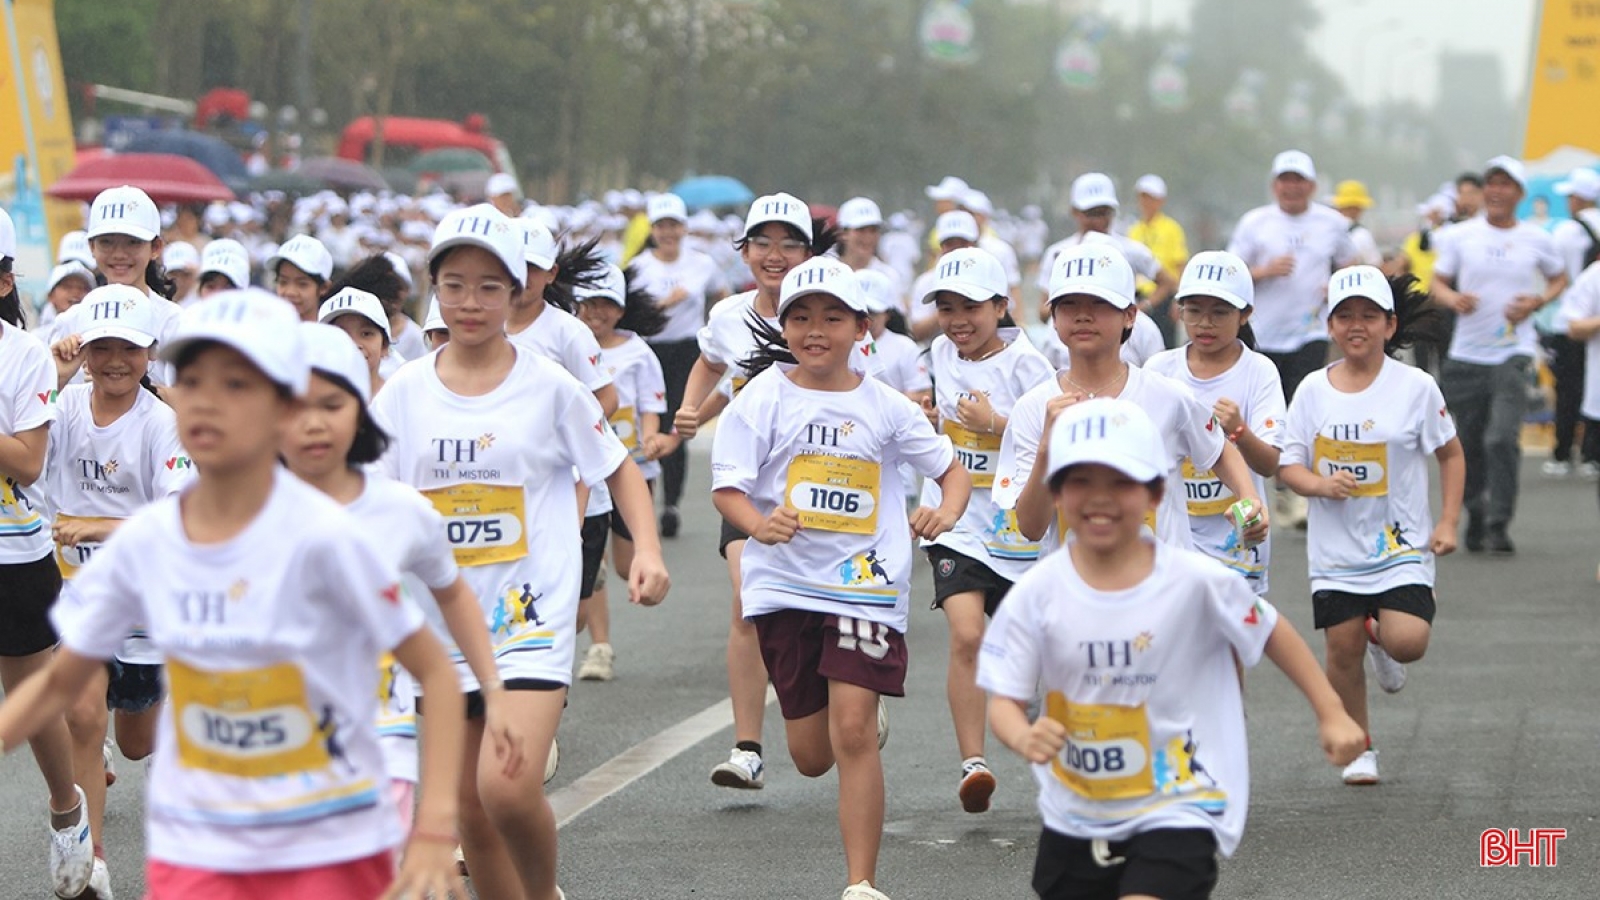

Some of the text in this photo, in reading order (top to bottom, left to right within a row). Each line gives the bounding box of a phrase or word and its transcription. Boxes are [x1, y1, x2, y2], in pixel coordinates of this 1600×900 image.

[101, 204, 125, 219] TH
[762, 201, 788, 215] TH
[456, 217, 491, 236] TH
[793, 268, 824, 287] TH
[940, 260, 961, 279] TH
[1063, 258, 1096, 278] TH
[1196, 264, 1224, 281] TH
[1336, 273, 1362, 290] TH
[91, 301, 120, 320] TH
[806, 423, 840, 446] TH
[1066, 416, 1106, 444] TH
[1329, 424, 1360, 440] TH
[431, 438, 477, 462] TH
[1184, 481, 1223, 499] 1107
[810, 487, 859, 513] 1106
[1079, 639, 1132, 668] TH
[201, 710, 286, 750] 1025
[1066, 739, 1125, 773] 1008
